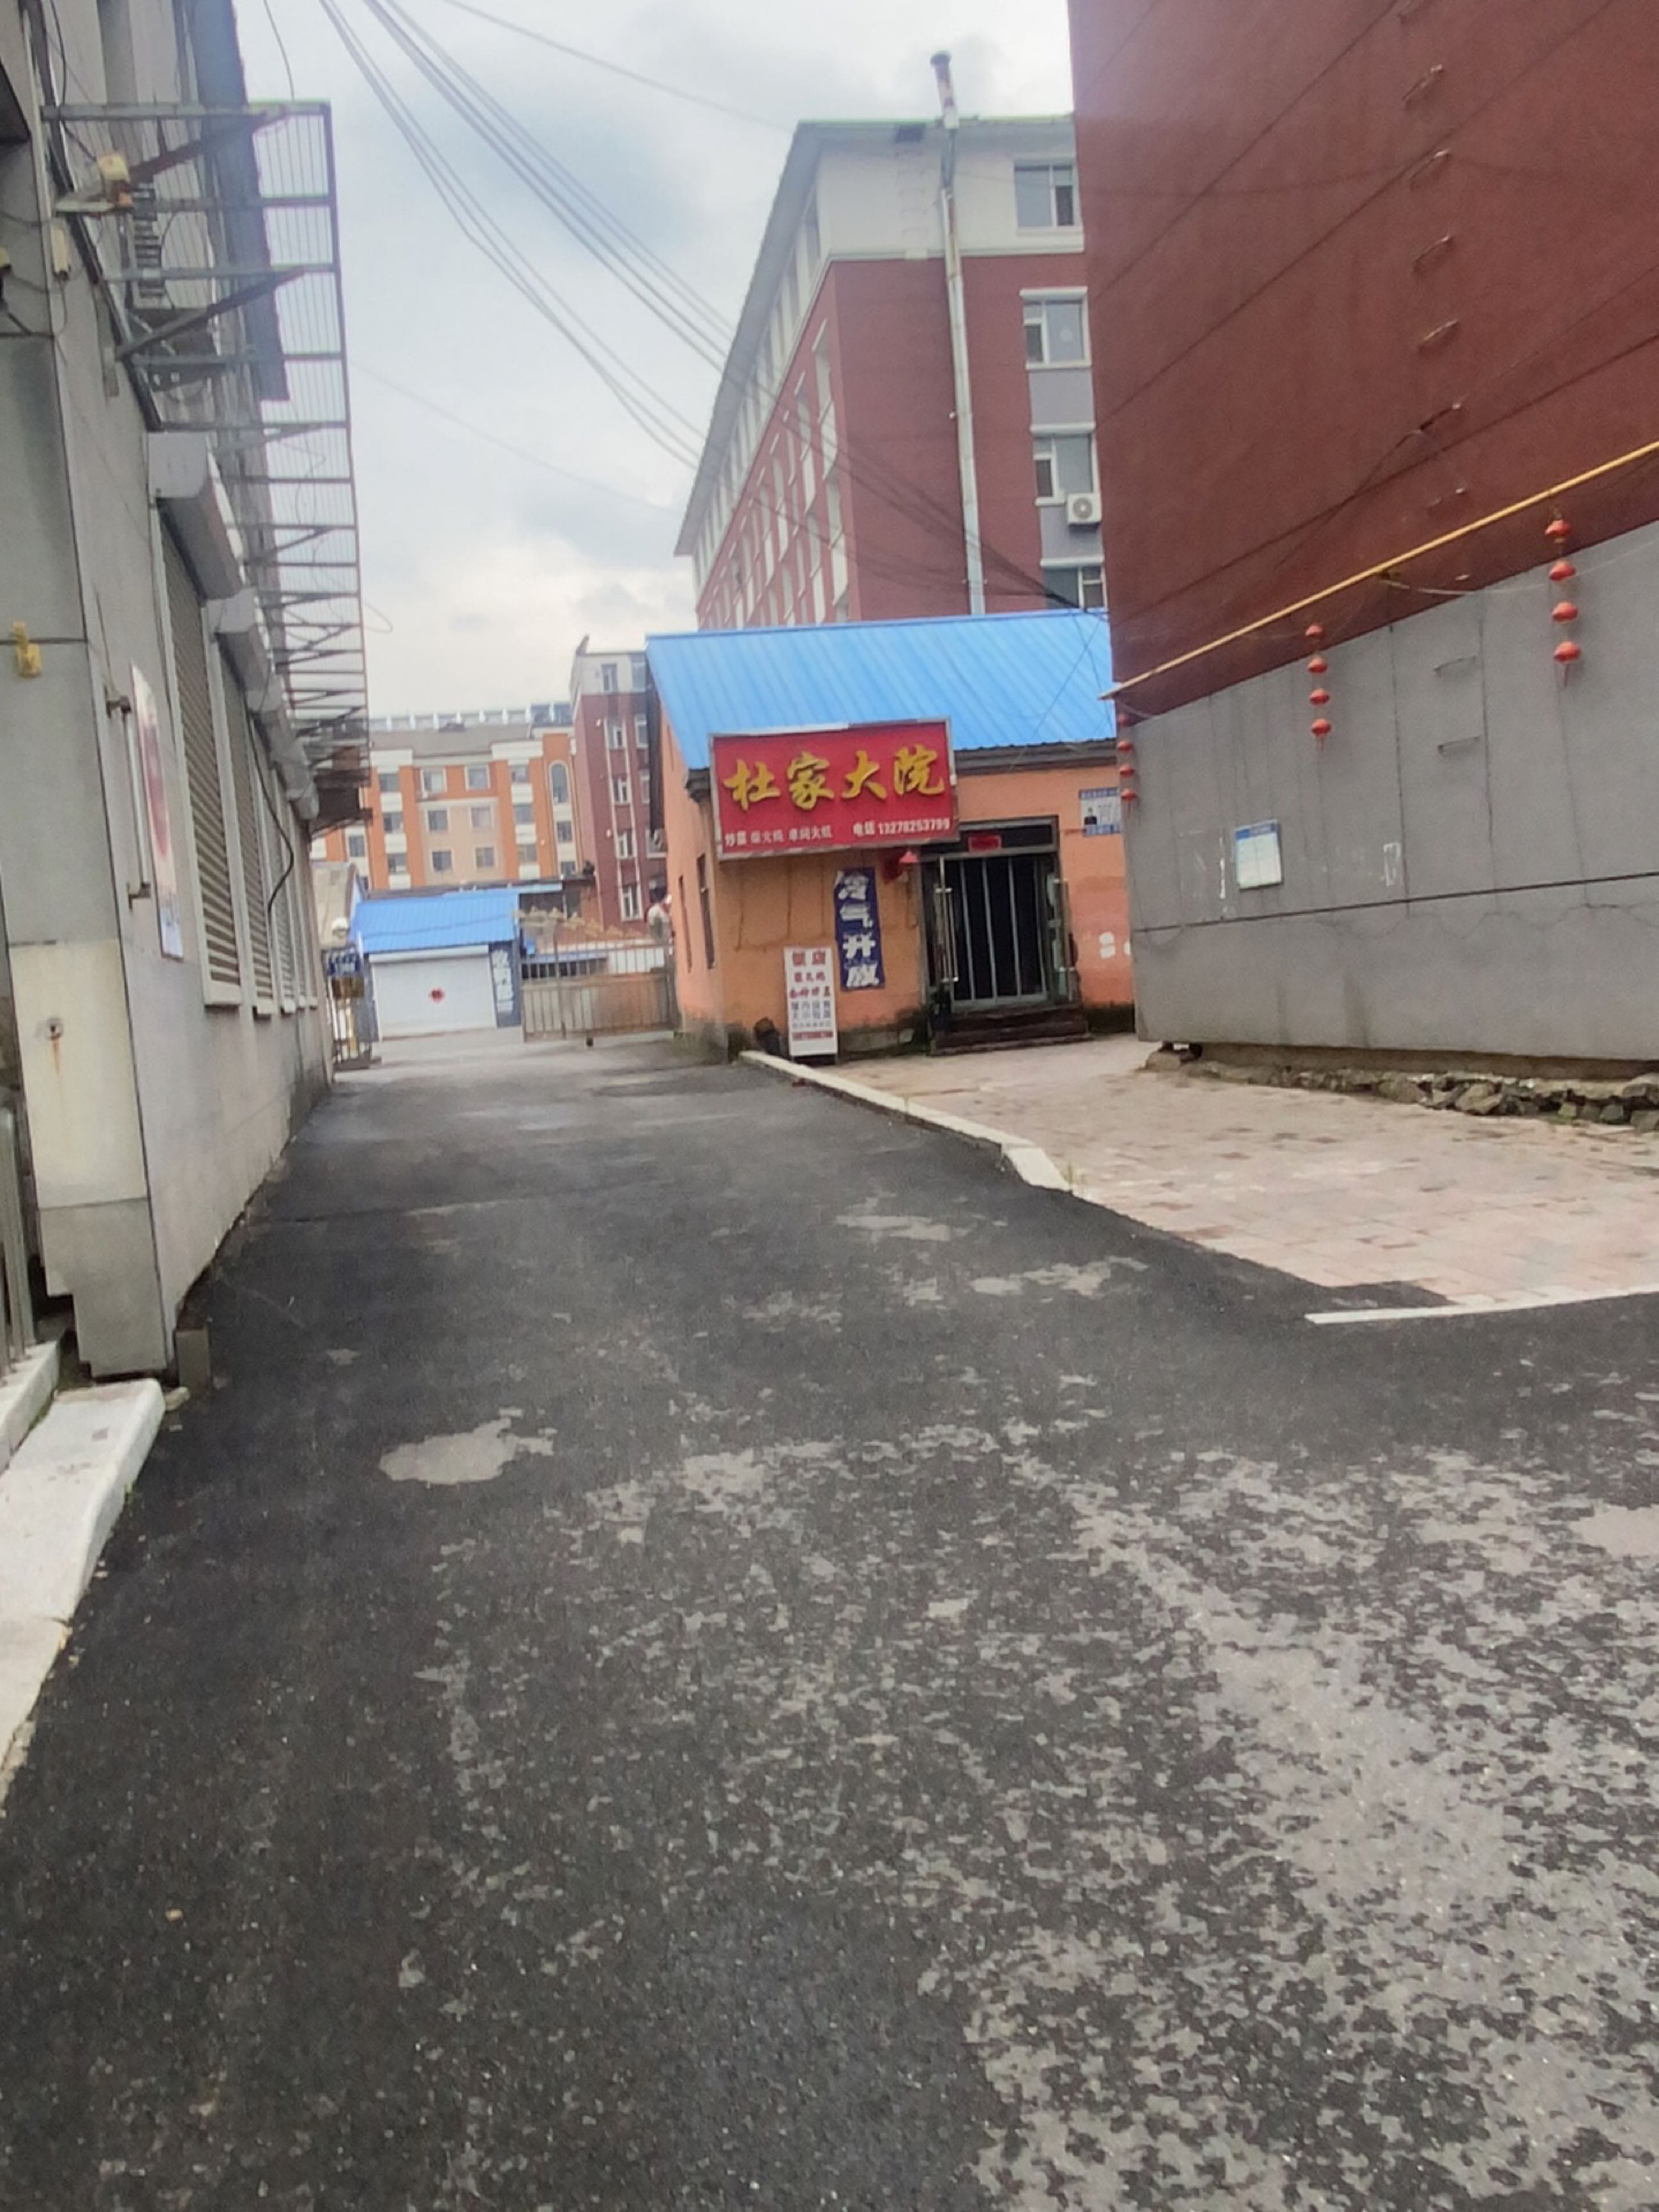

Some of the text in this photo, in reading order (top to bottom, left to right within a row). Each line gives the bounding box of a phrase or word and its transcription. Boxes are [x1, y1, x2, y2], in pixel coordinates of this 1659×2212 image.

[723, 744, 945, 811] 杜家大院
[834, 870, 879, 988] 冷气开放
